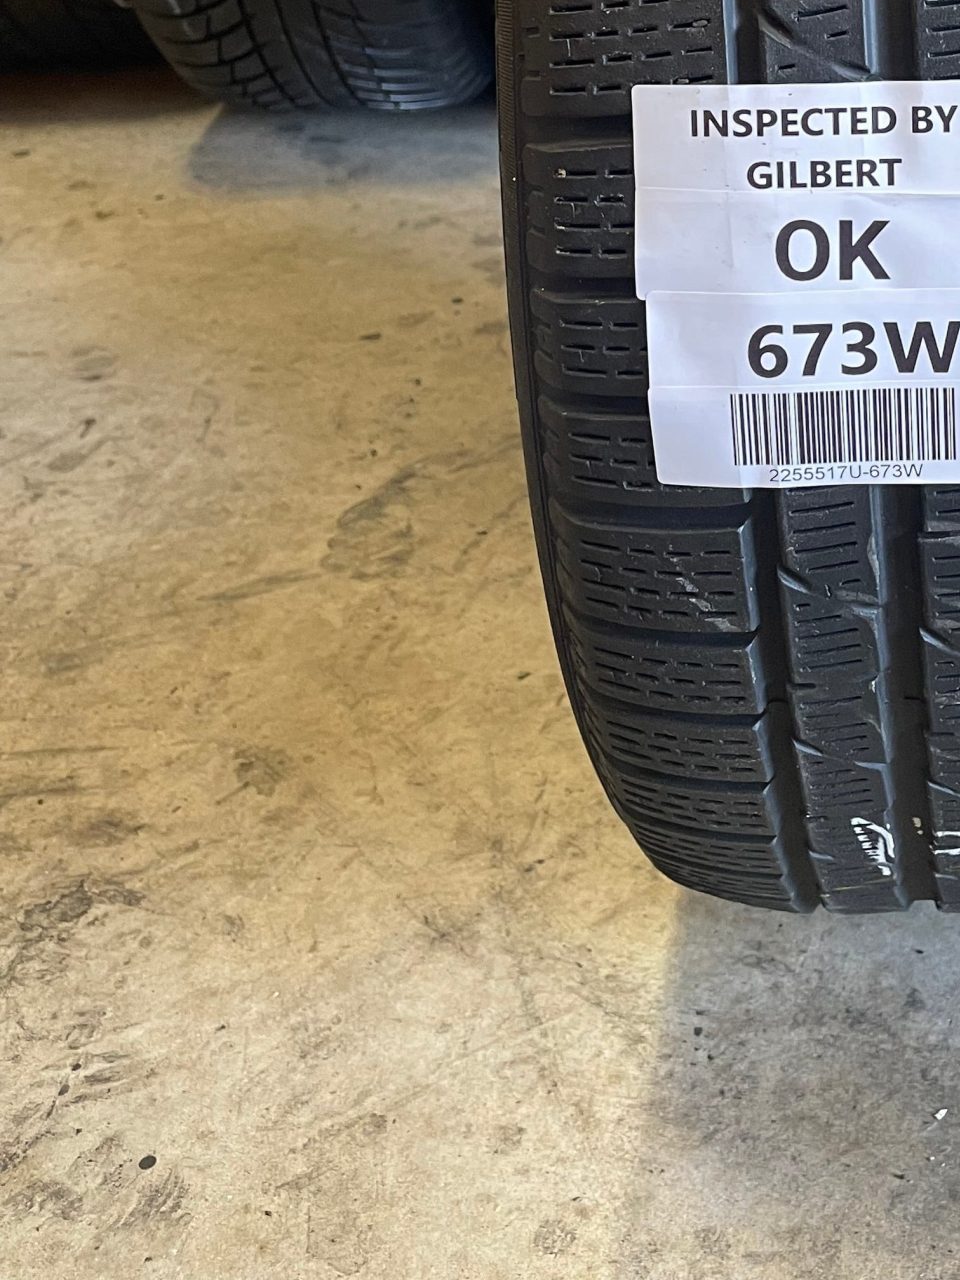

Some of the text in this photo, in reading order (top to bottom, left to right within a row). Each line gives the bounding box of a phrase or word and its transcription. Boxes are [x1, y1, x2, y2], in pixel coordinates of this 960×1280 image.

[689, 105, 958, 138] INSPECTED BY
[746, 158, 902, 189] GILBERT
[774, 219, 891, 282] OK
[769, 463, 924, 483] 2255517U-673W
